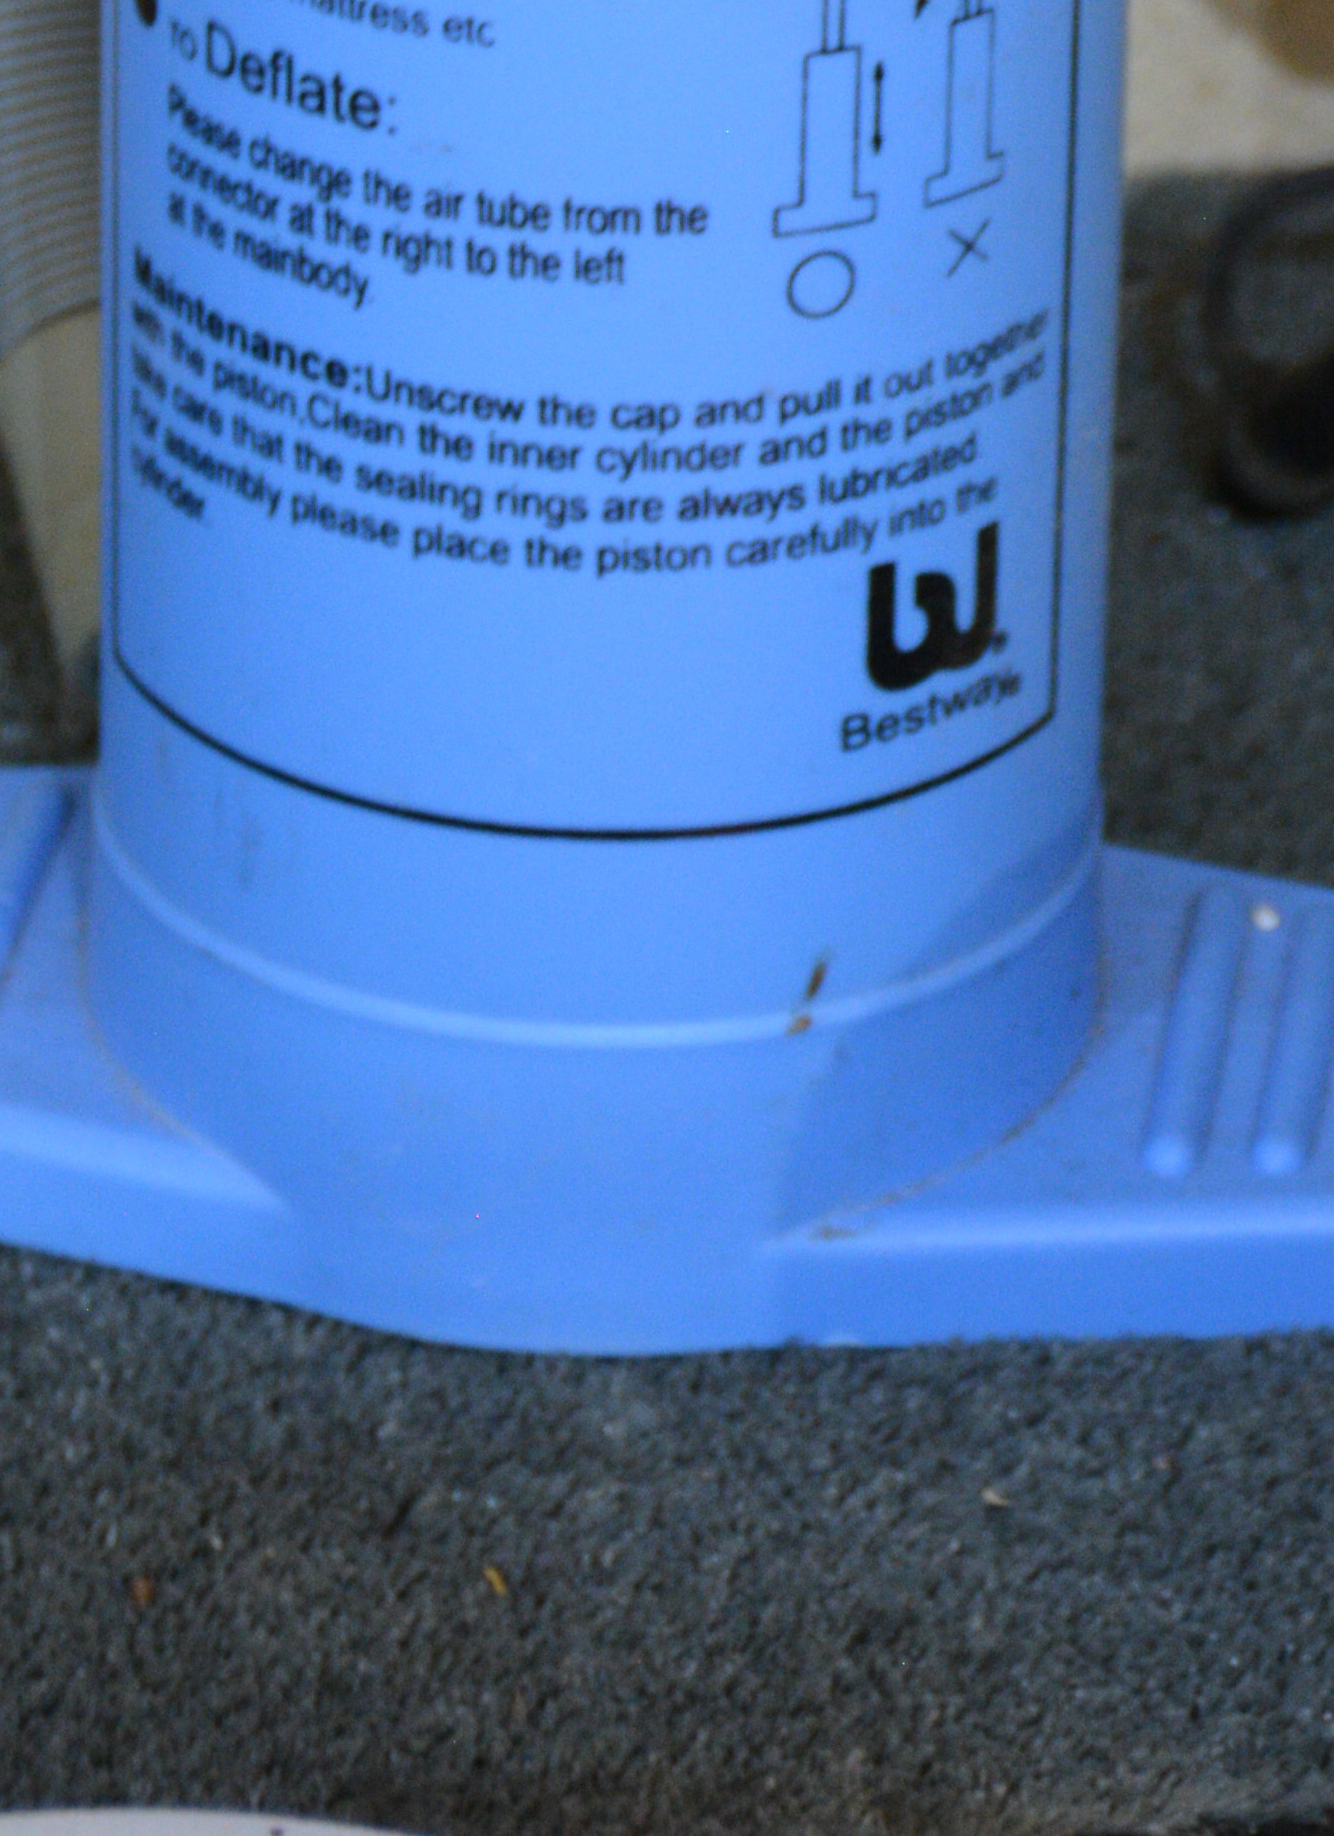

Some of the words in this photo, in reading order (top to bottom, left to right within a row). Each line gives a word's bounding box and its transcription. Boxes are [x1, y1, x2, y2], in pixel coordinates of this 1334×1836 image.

[206, 20, 396, 134] Deflate:
[249, 134, 352, 202] change
[363, 168, 411, 211] the
[424, 186, 464, 219] air
[477, 189, 550, 232] tube
[563, 199, 641, 234] from
[654, 198, 709, 235] the
[324, 209, 370, 252] the
[381, 222, 453, 275] right
[466, 238, 496, 275] to
[508, 241, 561, 282] the
[574, 248, 624, 284] left
[418, 423, 474, 462] the
[489, 431, 577, 470] inner
[595, 438, 742, 481] cylinder
[759, 426, 828, 466] and
[841, 412, 893, 452] the
[904, 379, 992, 442] piston
[537, 393, 596, 429] the
[610, 398, 681, 437] cap
[695, 392, 765, 428] and
[779, 377, 842, 425] pull
[854, 373, 872, 405] it
[884, 358, 934, 401] out
[294, 440, 344, 482] the
[355, 462, 482, 520] sealing
[495, 484, 587, 529] rings
[603, 493, 663, 523] are
[678, 481, 805, 534] always
[819, 433, 977, 507] lubricated
[291, 491, 400, 548] please
[412, 523, 510, 566] place
[524, 535, 582, 572] the
[596, 539, 711, 579] piston
[725, 513, 877, 568] carefully
[888, 492, 946, 539] into
